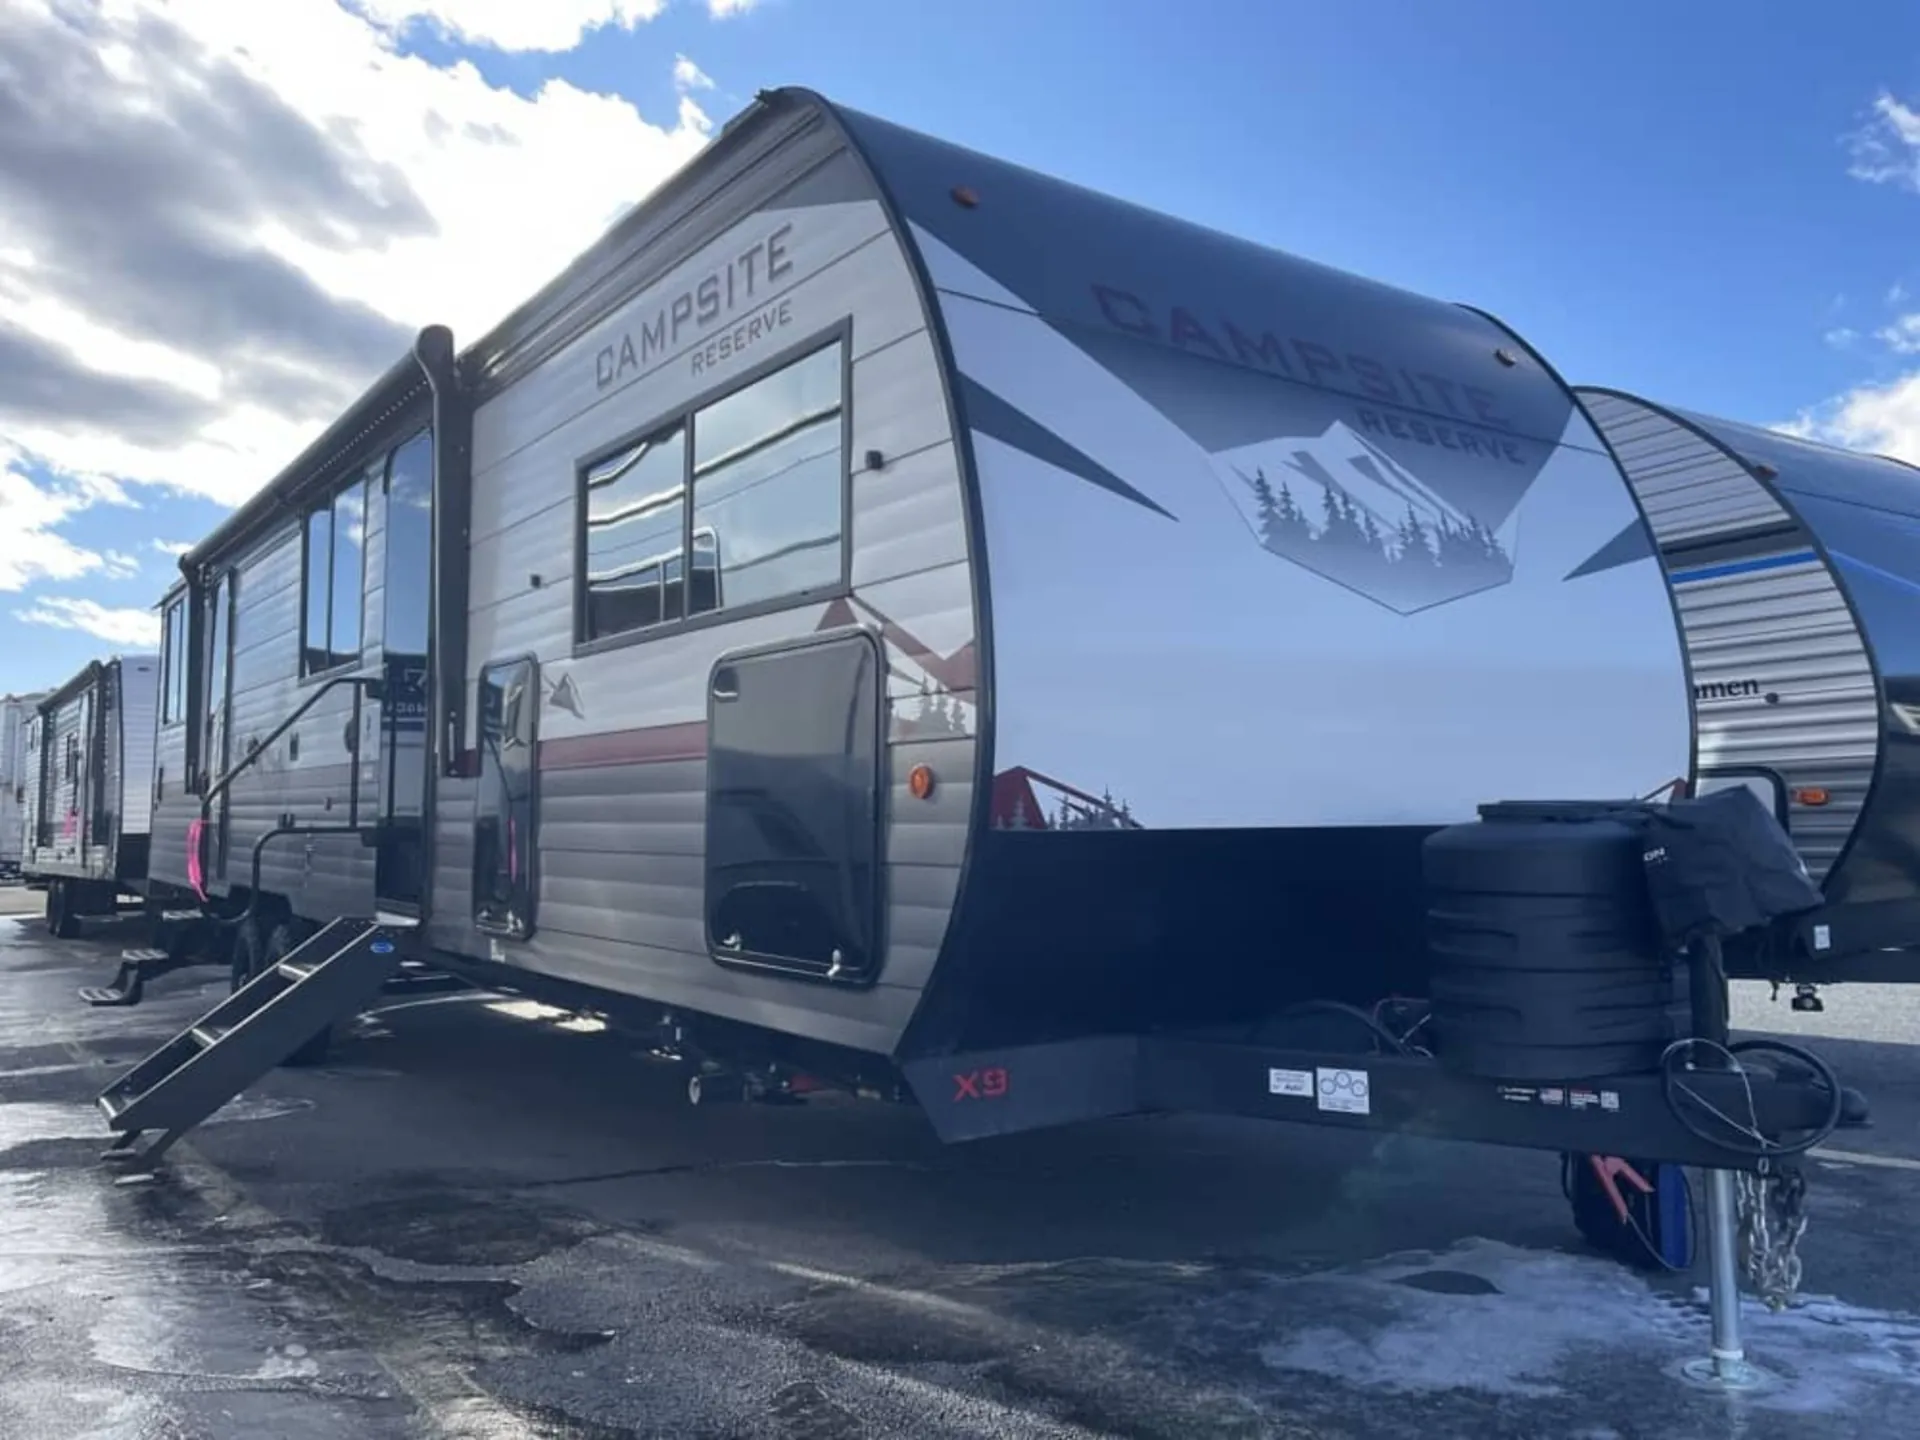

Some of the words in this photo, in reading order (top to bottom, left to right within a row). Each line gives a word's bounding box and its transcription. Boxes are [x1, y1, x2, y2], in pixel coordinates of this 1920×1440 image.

[596, 222, 794, 389] CAMPSITE
[691, 299, 794, 376] RESERVE
[1091, 283, 1510, 427] CAMPSITE
[1355, 407, 1526, 465] RESERVE
[952, 1069, 1007, 1101] X9
